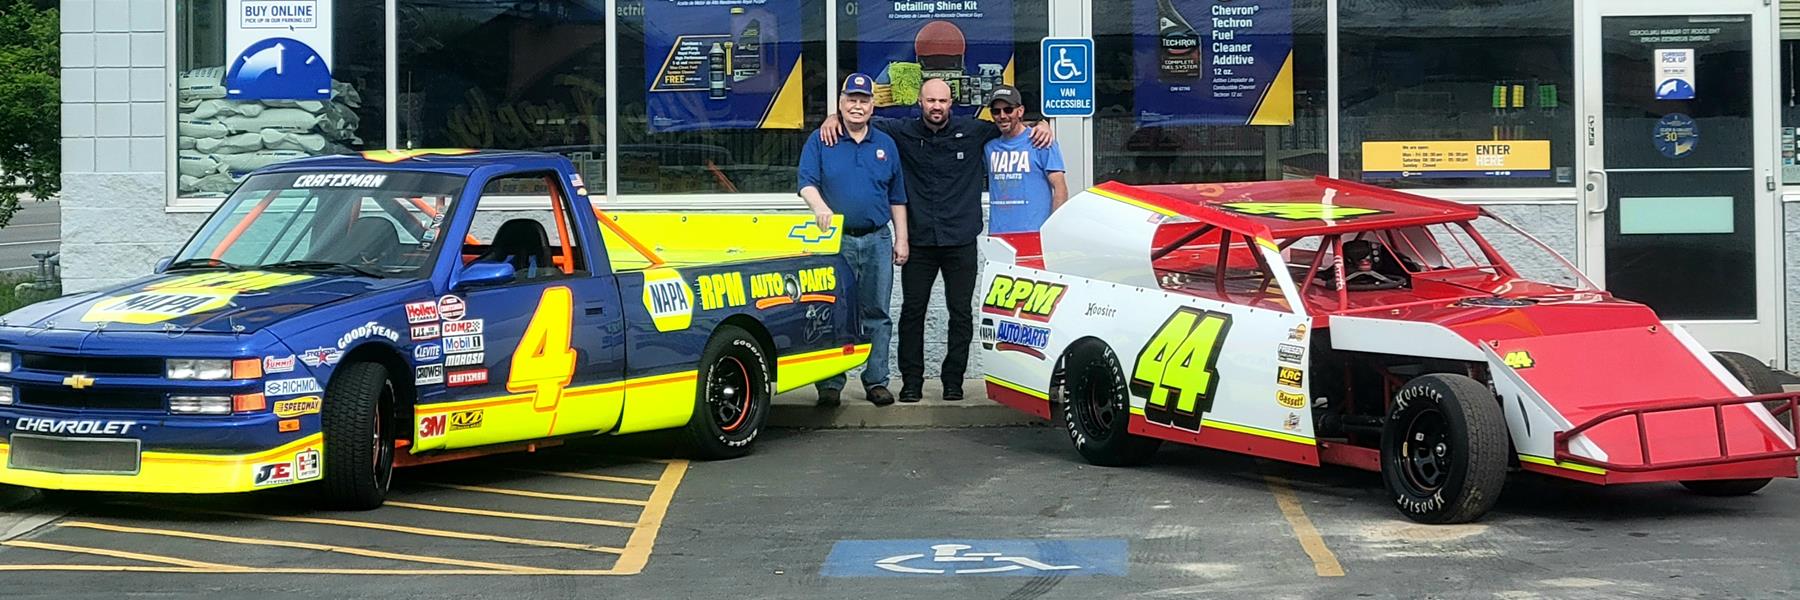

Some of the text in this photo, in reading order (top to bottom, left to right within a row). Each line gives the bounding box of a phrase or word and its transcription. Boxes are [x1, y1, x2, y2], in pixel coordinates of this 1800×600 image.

[245, 5, 312, 16] BUY ONLINE
[894, 1, 977, 12] Detailing Shine Kit
[1212, 17, 1252, 28] Techron
[1212, 30, 1234, 40] Fuel
[1212, 42, 1252, 53] Cleaner
[1212, 54, 1254, 65] Additive
[665, 75, 685, 84] FREE
[1060, 88, 1076, 96] VAN
[1045, 100, 1091, 108] ACCESSIBLE
[1664, 131, 1678, 142] 30
[1476, 144, 1510, 154] ENTER
[990, 151, 1030, 172] NAPA
[1476, 156, 1504, 166] HERE
[293, 174, 388, 188] CRAFTSMAN
[699, 266, 836, 310] RPM AUTO PARTS
[650, 280, 689, 315] NAPA
[983, 274, 1066, 317] RPM
[444, 322, 472, 332] COMP
[338, 322, 400, 349] GOODYEAR
[996, 320, 1020, 344] AUTO
[1020, 324, 1050, 349] PARTS
[446, 336, 481, 350] Mobil 1
[506, 285, 577, 413] 4
[445, 352, 484, 366] MOROSO
[1131, 307, 1231, 424] 44
[1504, 350, 1536, 369] 44
[416, 366, 441, 379] CROWER
[1280, 369, 1302, 380] KRC
[1395, 384, 1443, 413] Hoosier
[284, 400, 318, 412] SPEEDWAY
[16, 418, 136, 434] CHEVROLET
[420, 414, 446, 438] 3M
[256, 463, 291, 485] JE
